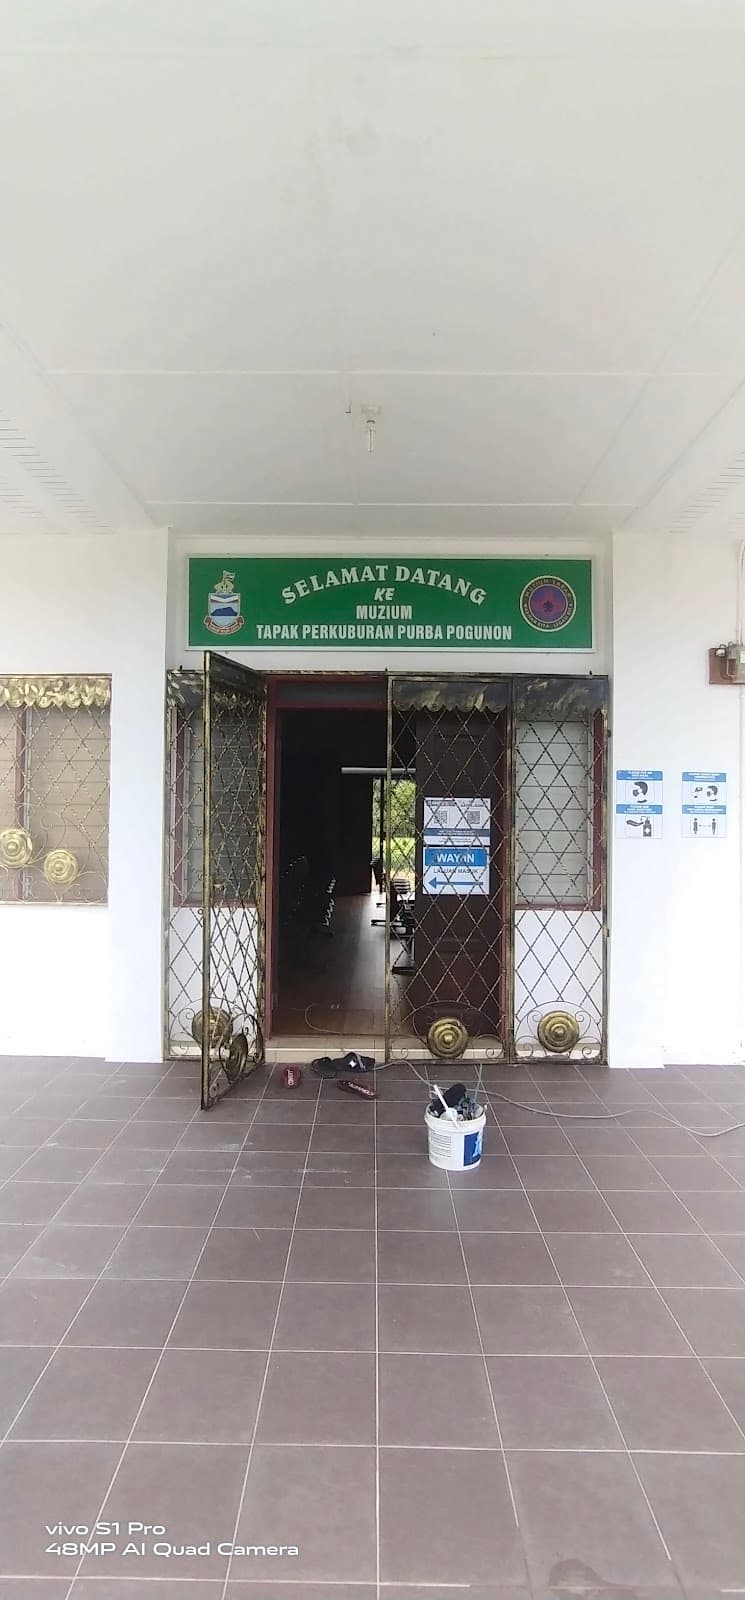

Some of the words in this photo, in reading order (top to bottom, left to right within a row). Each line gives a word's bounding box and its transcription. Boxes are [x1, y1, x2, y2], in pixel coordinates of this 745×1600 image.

[281, 565, 388, 604] SELAMAT
[395, 566, 487, 605] DATANG
[374, 587, 395, 602] KE
[356, 605, 413, 620] MUZIUM
[256, 625, 299, 640] TAPAK
[302, 625, 394, 640] PERKUBURAN
[399, 625, 443, 640] PURBA
[447, 625, 512, 641] POGUNON
[436, 853, 460, 863] WAY
